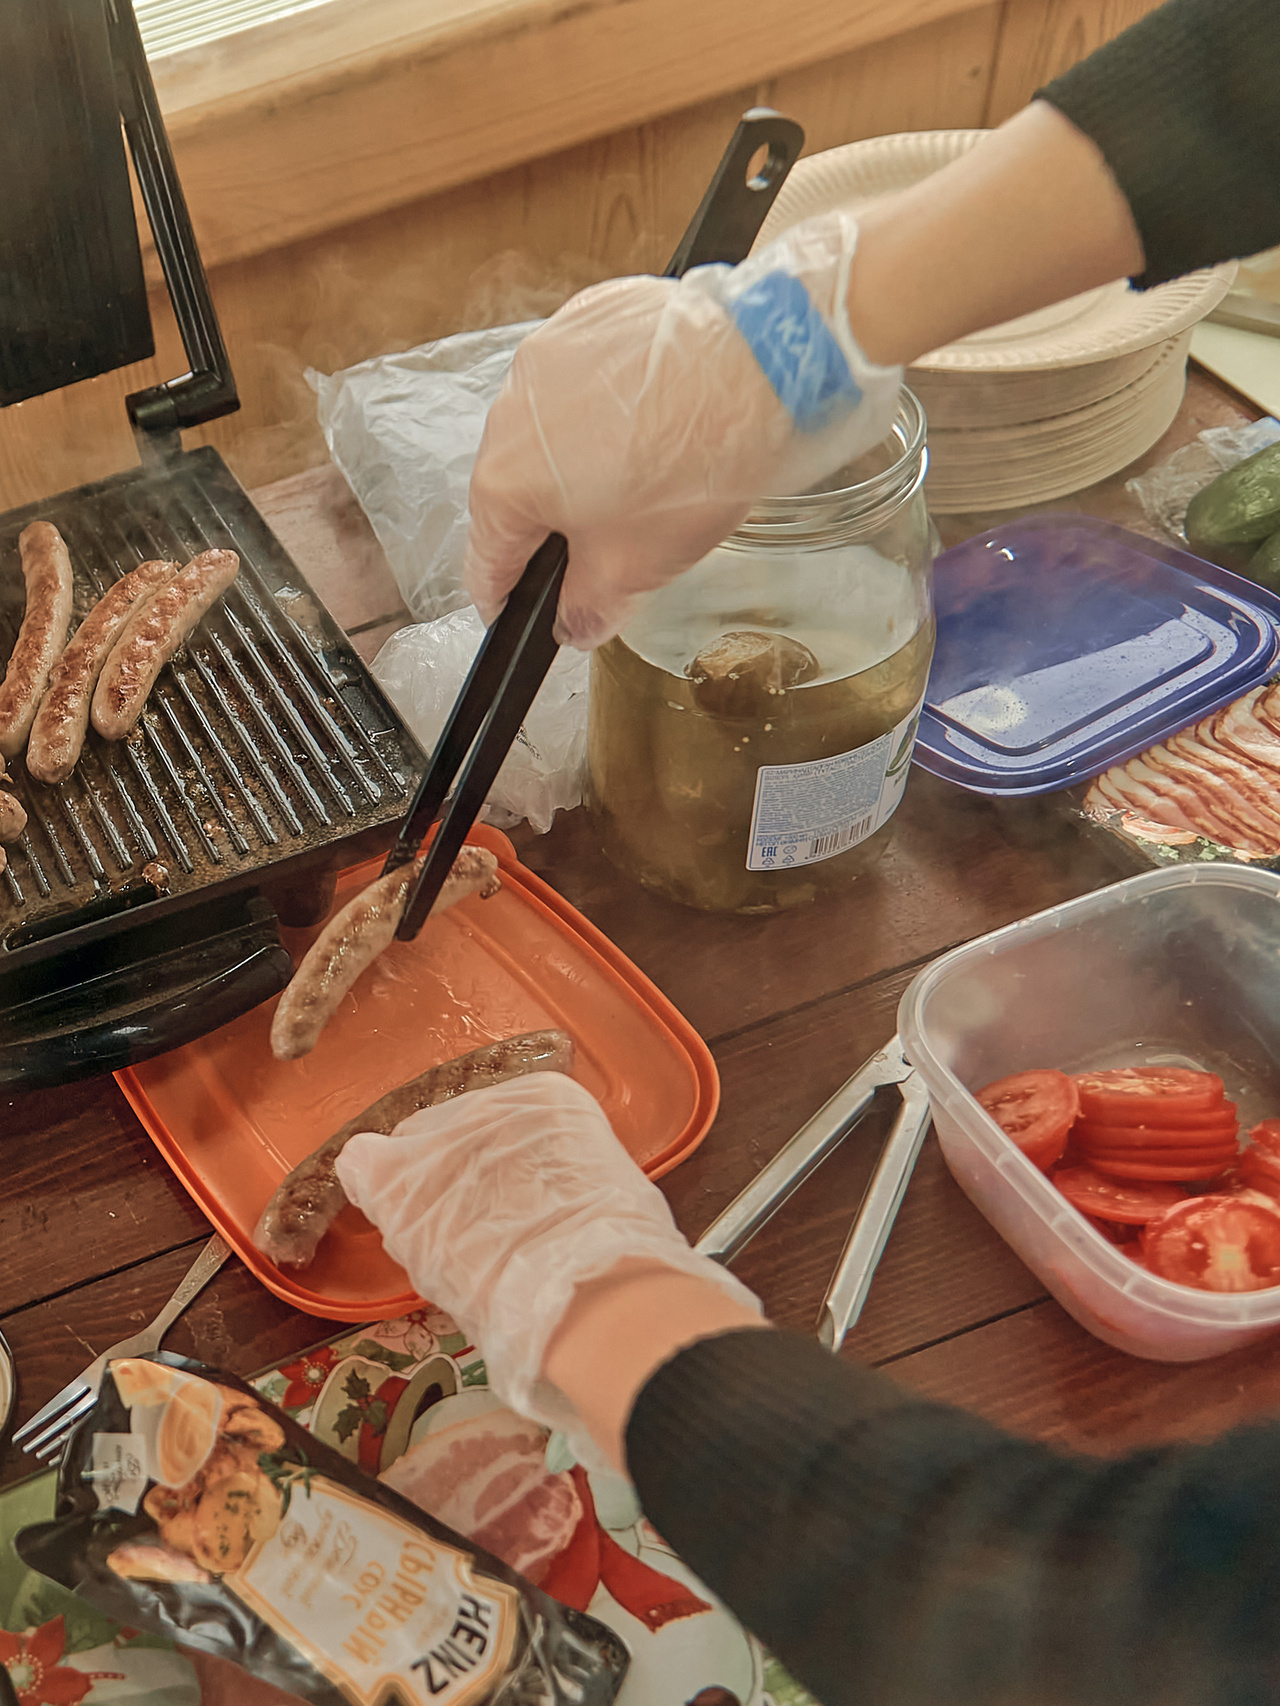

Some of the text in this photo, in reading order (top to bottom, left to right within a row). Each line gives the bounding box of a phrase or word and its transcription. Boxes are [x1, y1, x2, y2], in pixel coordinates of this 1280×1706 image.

[341, 1560, 387, 1611] СОУС
[341, 1539, 437, 1667] СЫРНЫЙ
[410, 1593, 492, 1696] HEINZ
